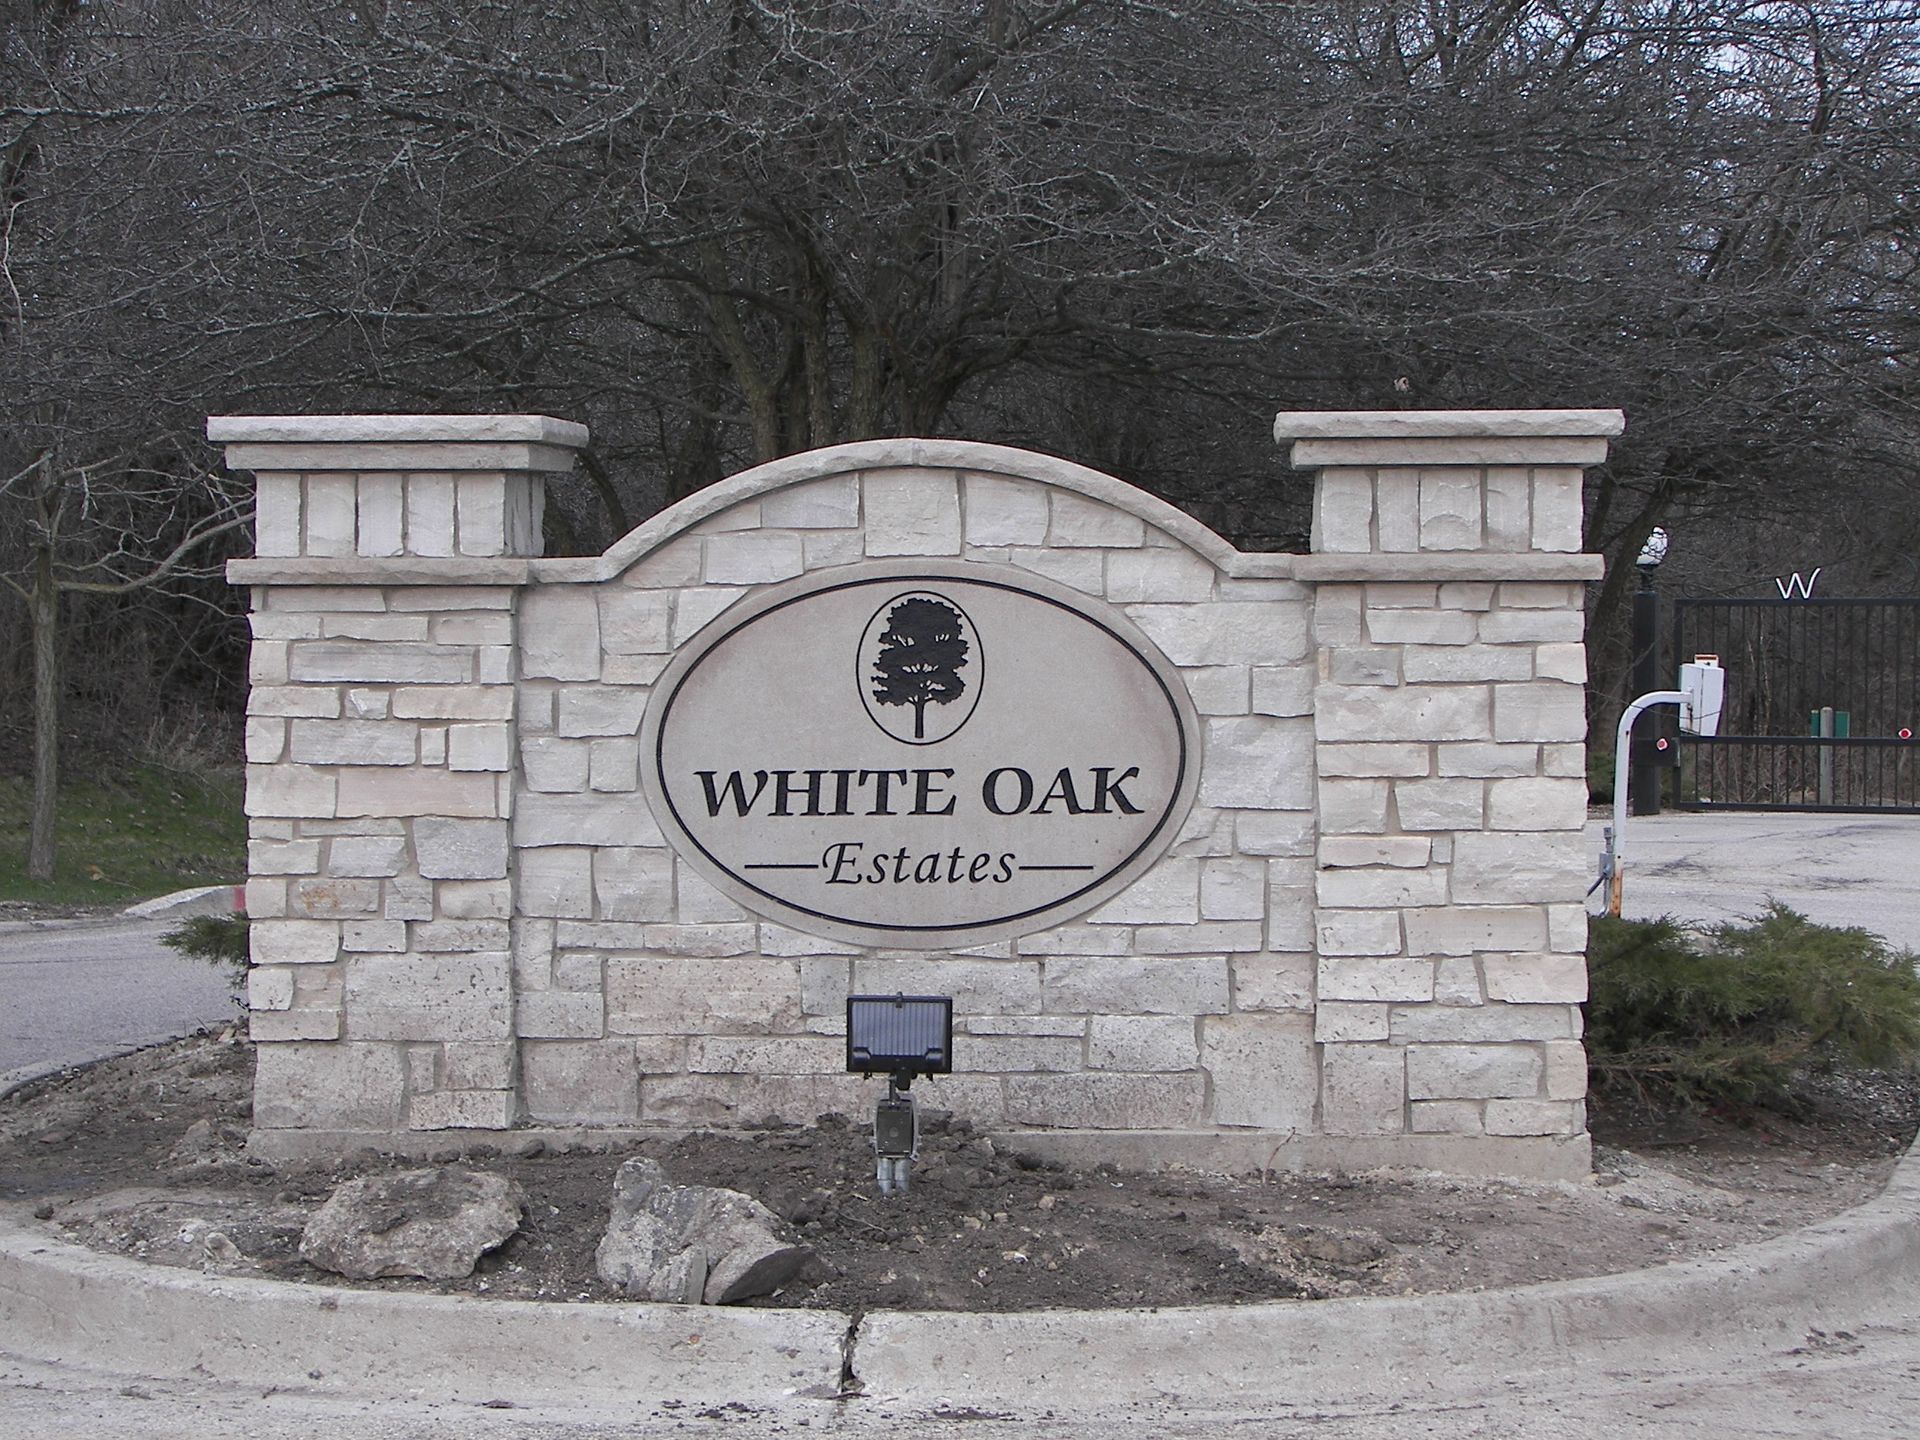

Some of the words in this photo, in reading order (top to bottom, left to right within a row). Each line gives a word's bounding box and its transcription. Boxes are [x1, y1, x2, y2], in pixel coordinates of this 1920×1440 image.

[1775, 567, 1821, 599] W
[693, 768, 957, 817] WHITE
[982, 766, 1145, 815] OAK
[822, 842, 1016, 885] Estates
